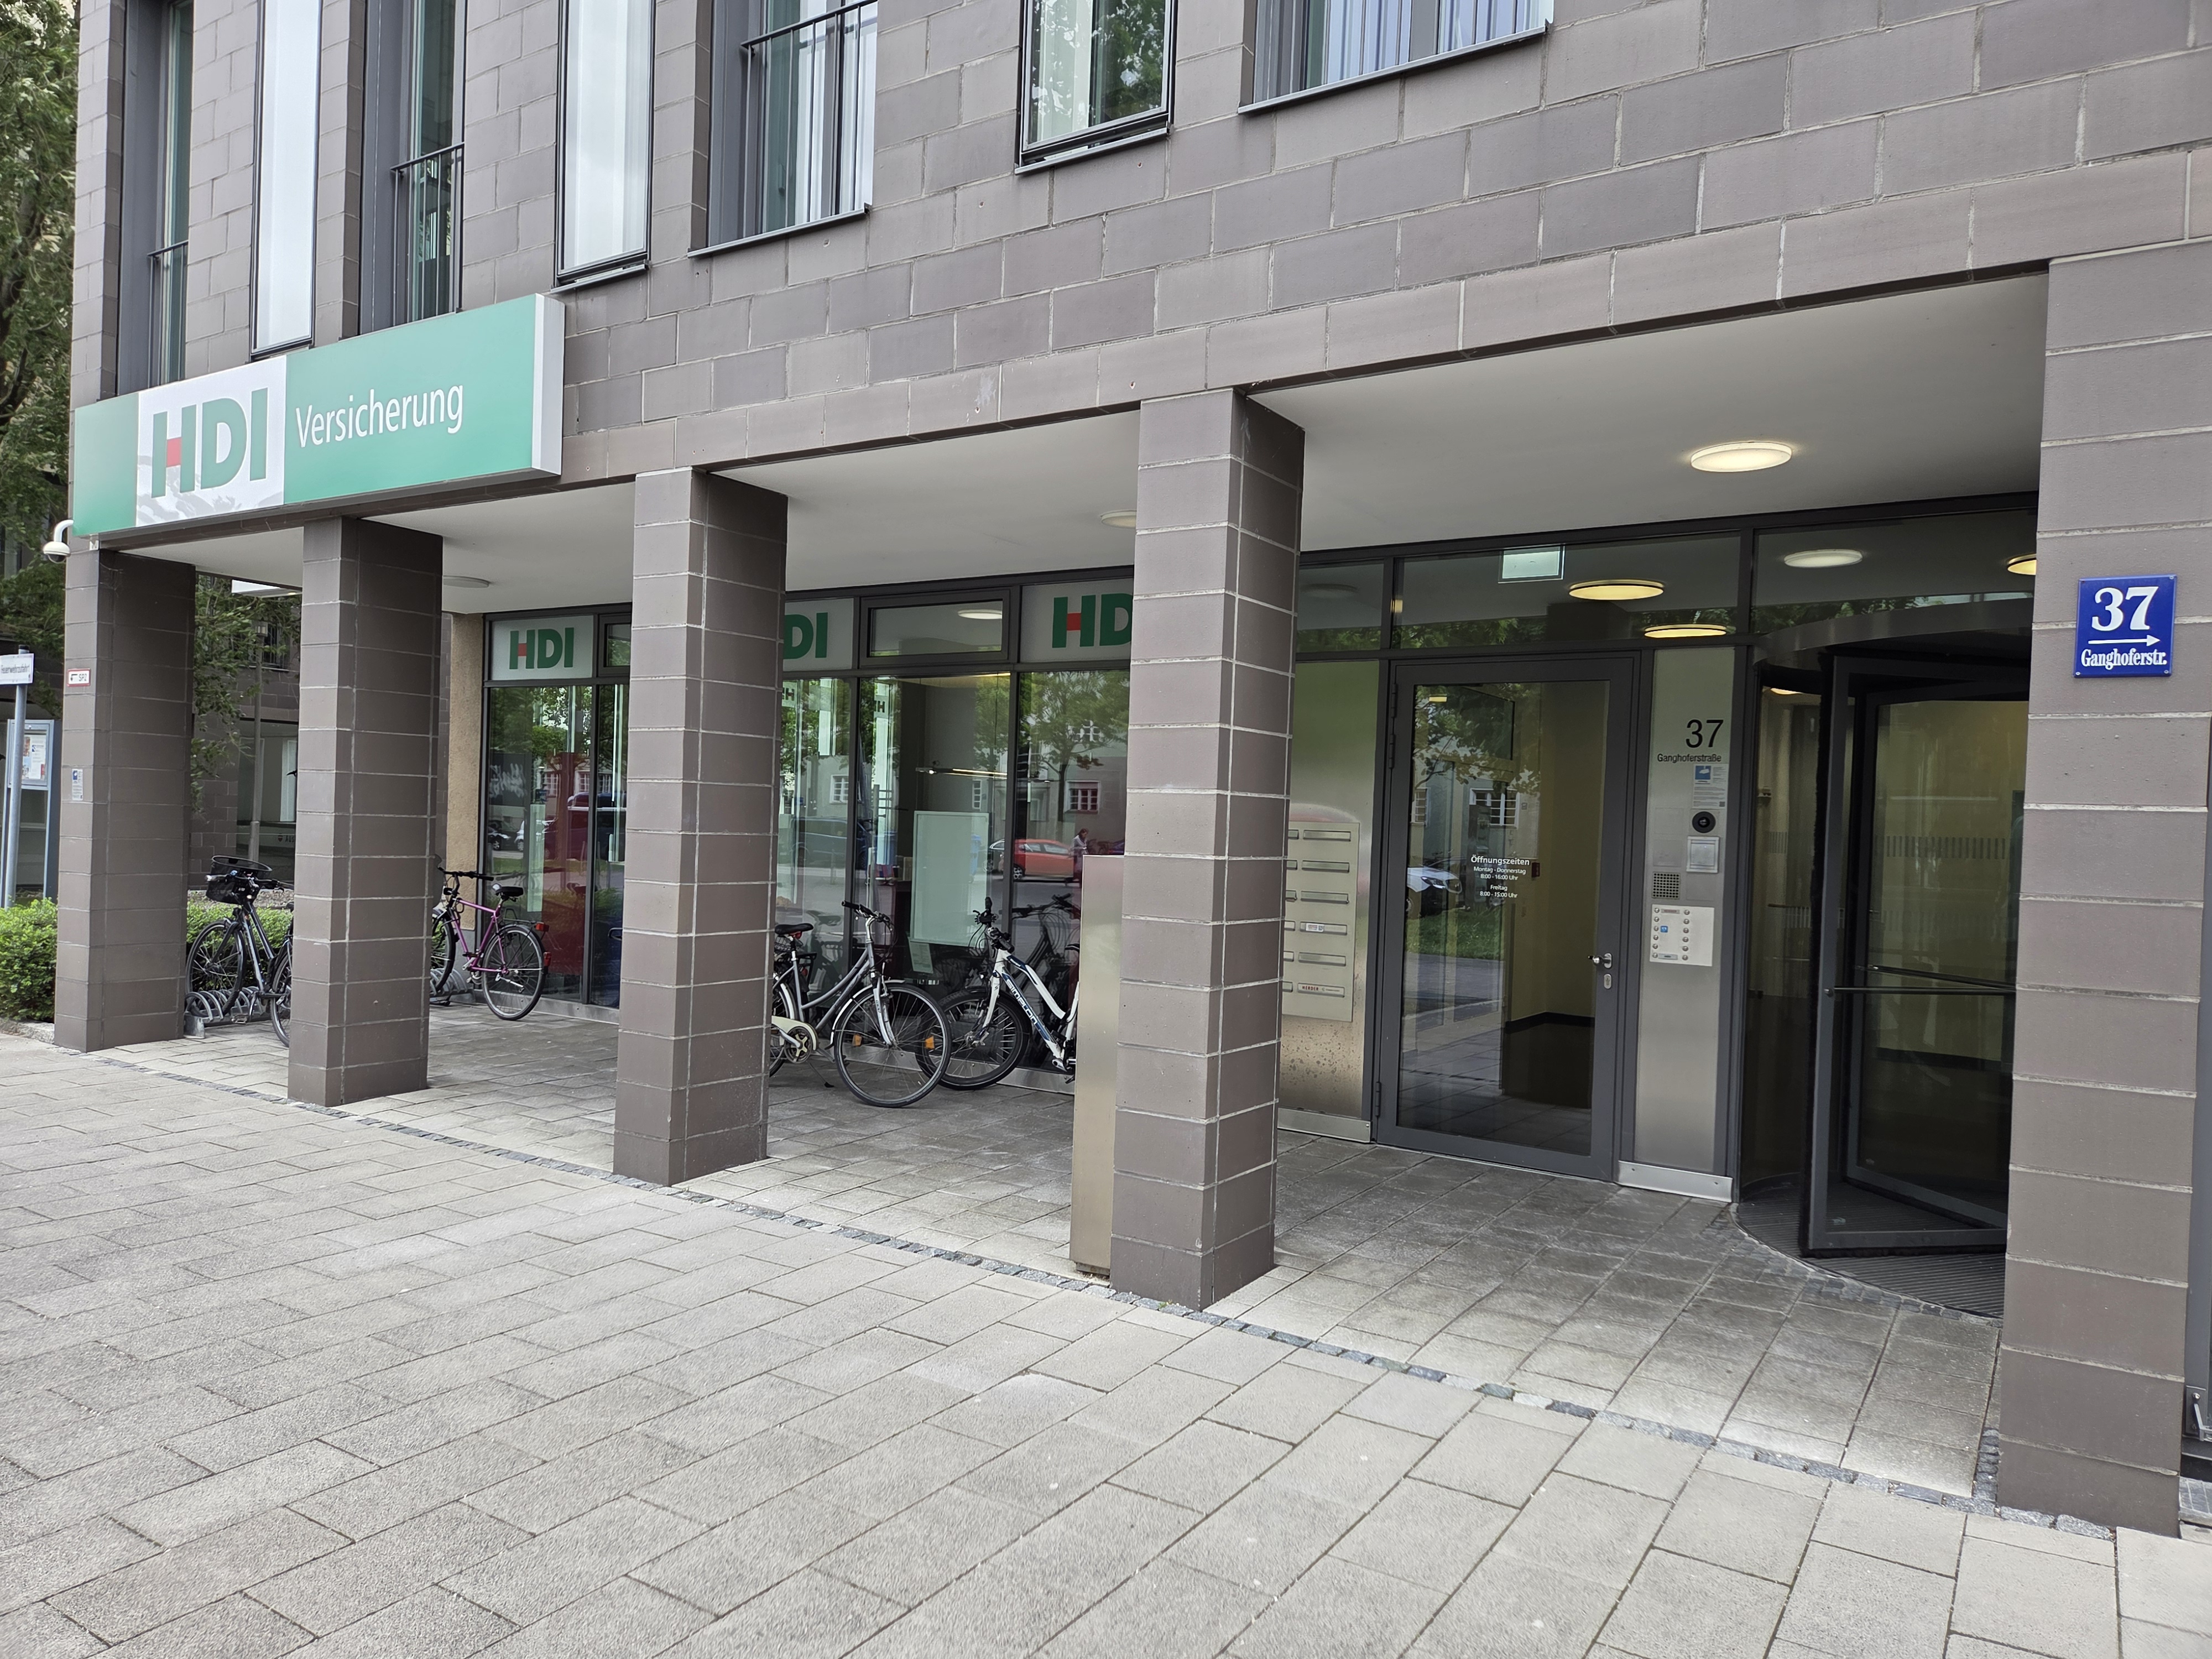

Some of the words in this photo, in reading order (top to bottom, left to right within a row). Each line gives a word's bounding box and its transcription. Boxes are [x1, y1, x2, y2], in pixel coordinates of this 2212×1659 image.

[152, 387, 268, 498] HDI
[296, 385, 463, 447] Versicherung
[1052, 593, 1133, 648] HD
[2091, 586, 2159, 632] 37
[509, 627, 574, 669] HDI
[783, 612, 828, 659] DI
[2081, 648, 2167, 670] Ganghoferstr.
[1686, 719, 1724, 748] 37
[1657, 753, 1721, 764] Ganghoferstraße
[1471, 854, 1530, 865] Öffnungszeiten
[1006, 978, 1037, 1025] SIMPLON
